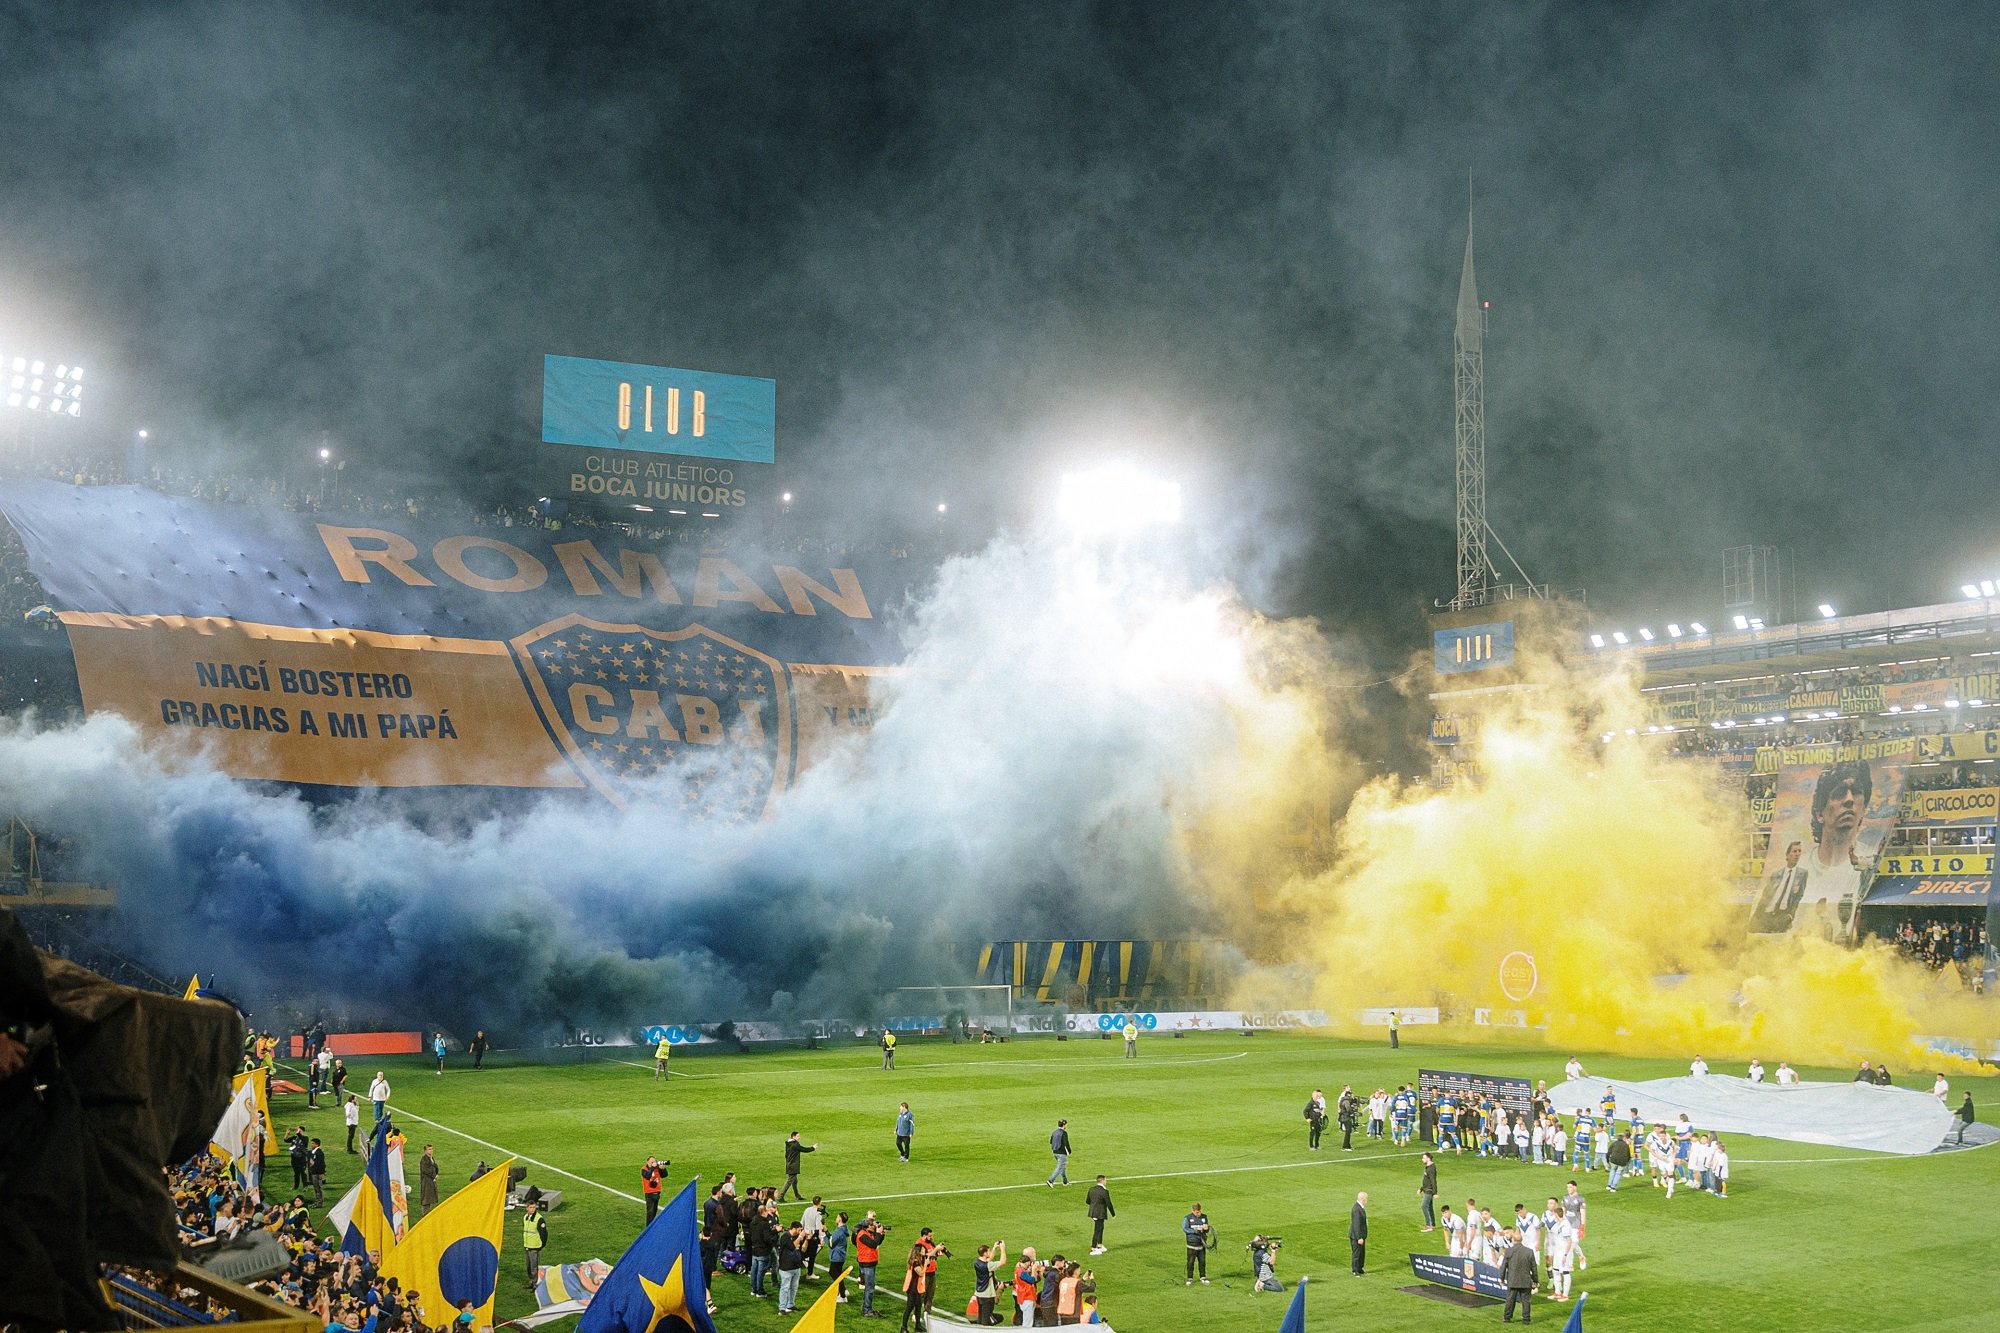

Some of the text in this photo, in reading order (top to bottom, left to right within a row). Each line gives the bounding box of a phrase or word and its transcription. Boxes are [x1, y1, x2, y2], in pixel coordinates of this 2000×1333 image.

[618, 382, 706, 437] CLUB
[585, 455, 734, 485] CLUB ATLÉTICO
[571, 473, 746, 507] BOCA JUNIORS
[195, 660, 413, 699] NACÍ BOSTERO
[1842, 685, 1880, 699] UNION
[567, 682, 766, 747] CABJ
[1789, 691, 1839, 709] CASANOVA
[160, 698, 459, 739] GRACIAS A MI PAPÁ
[1783, 737, 1914, 765] ESTAMOS CON USTEDES
[1925, 794, 1995, 812] CIRCOLOCO
